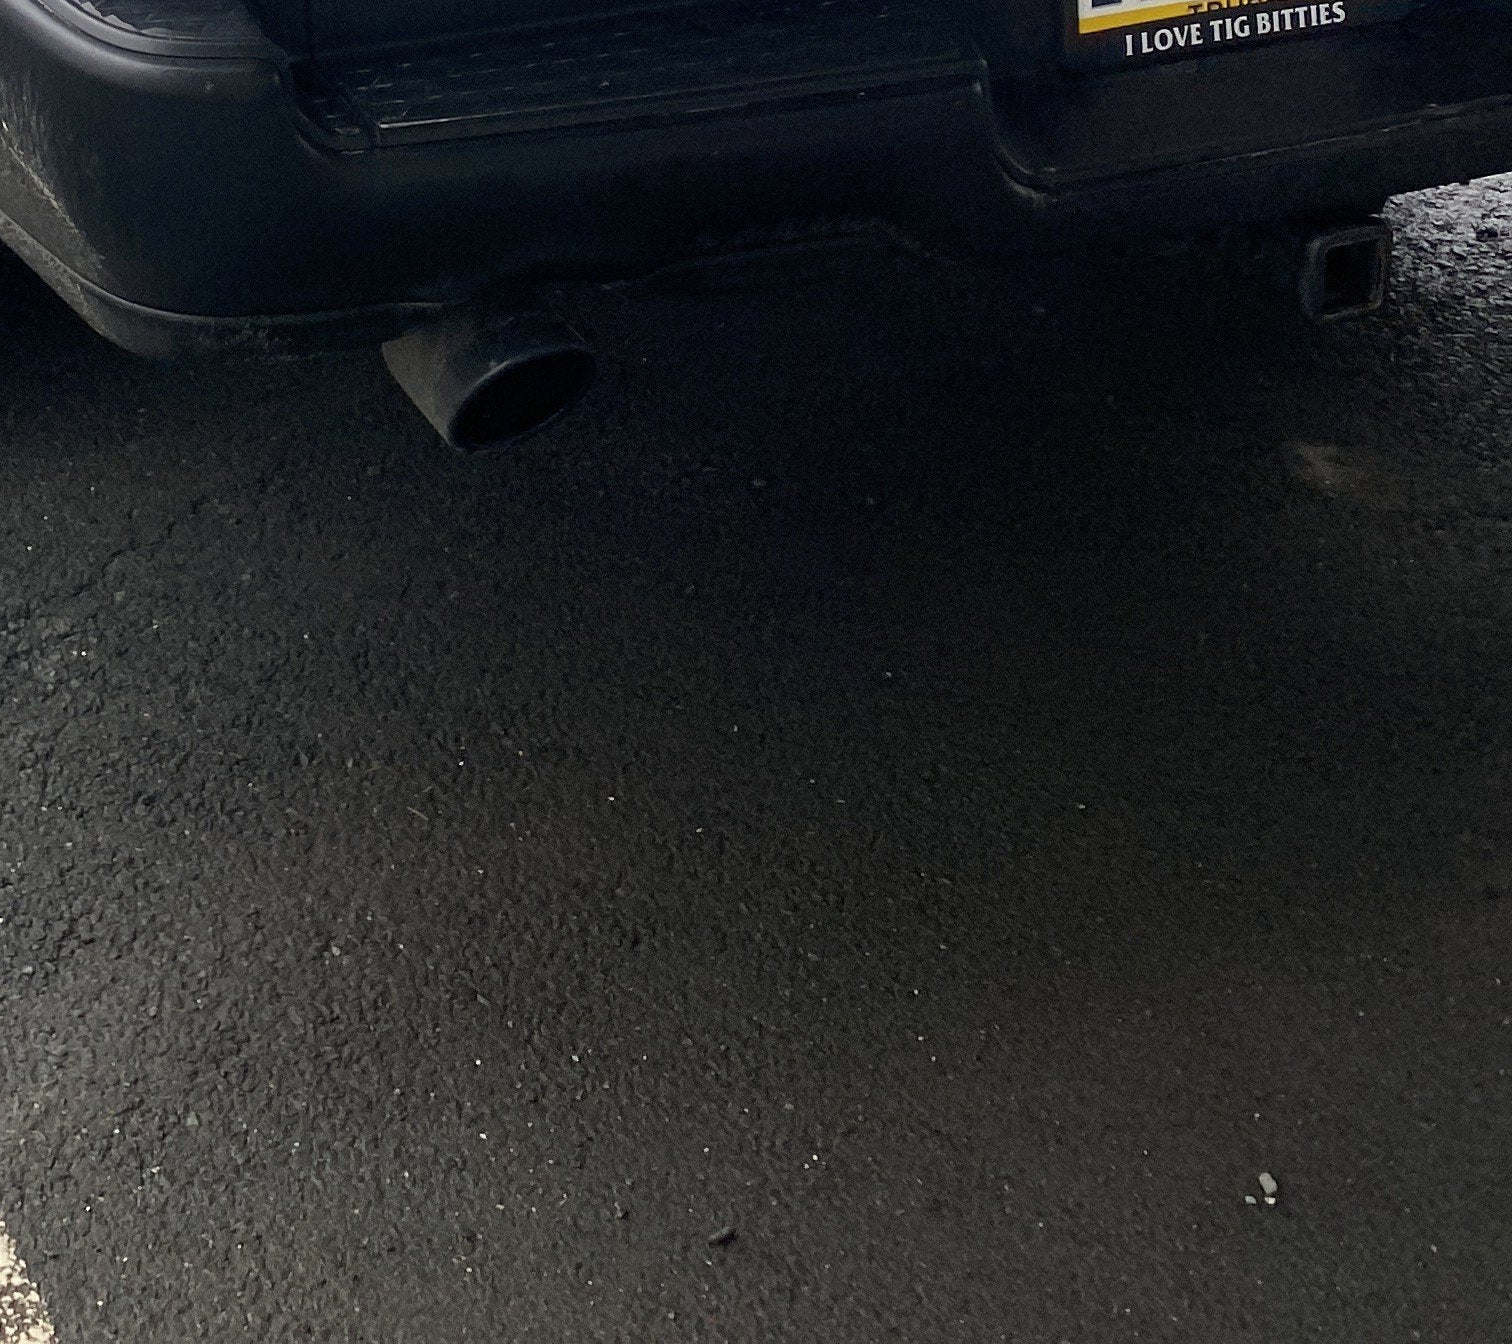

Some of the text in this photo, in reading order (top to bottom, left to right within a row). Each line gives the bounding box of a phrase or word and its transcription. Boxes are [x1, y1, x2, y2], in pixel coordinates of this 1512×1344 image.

[1125, 1, 1346, 57] I LOVE TIG BITTIES
